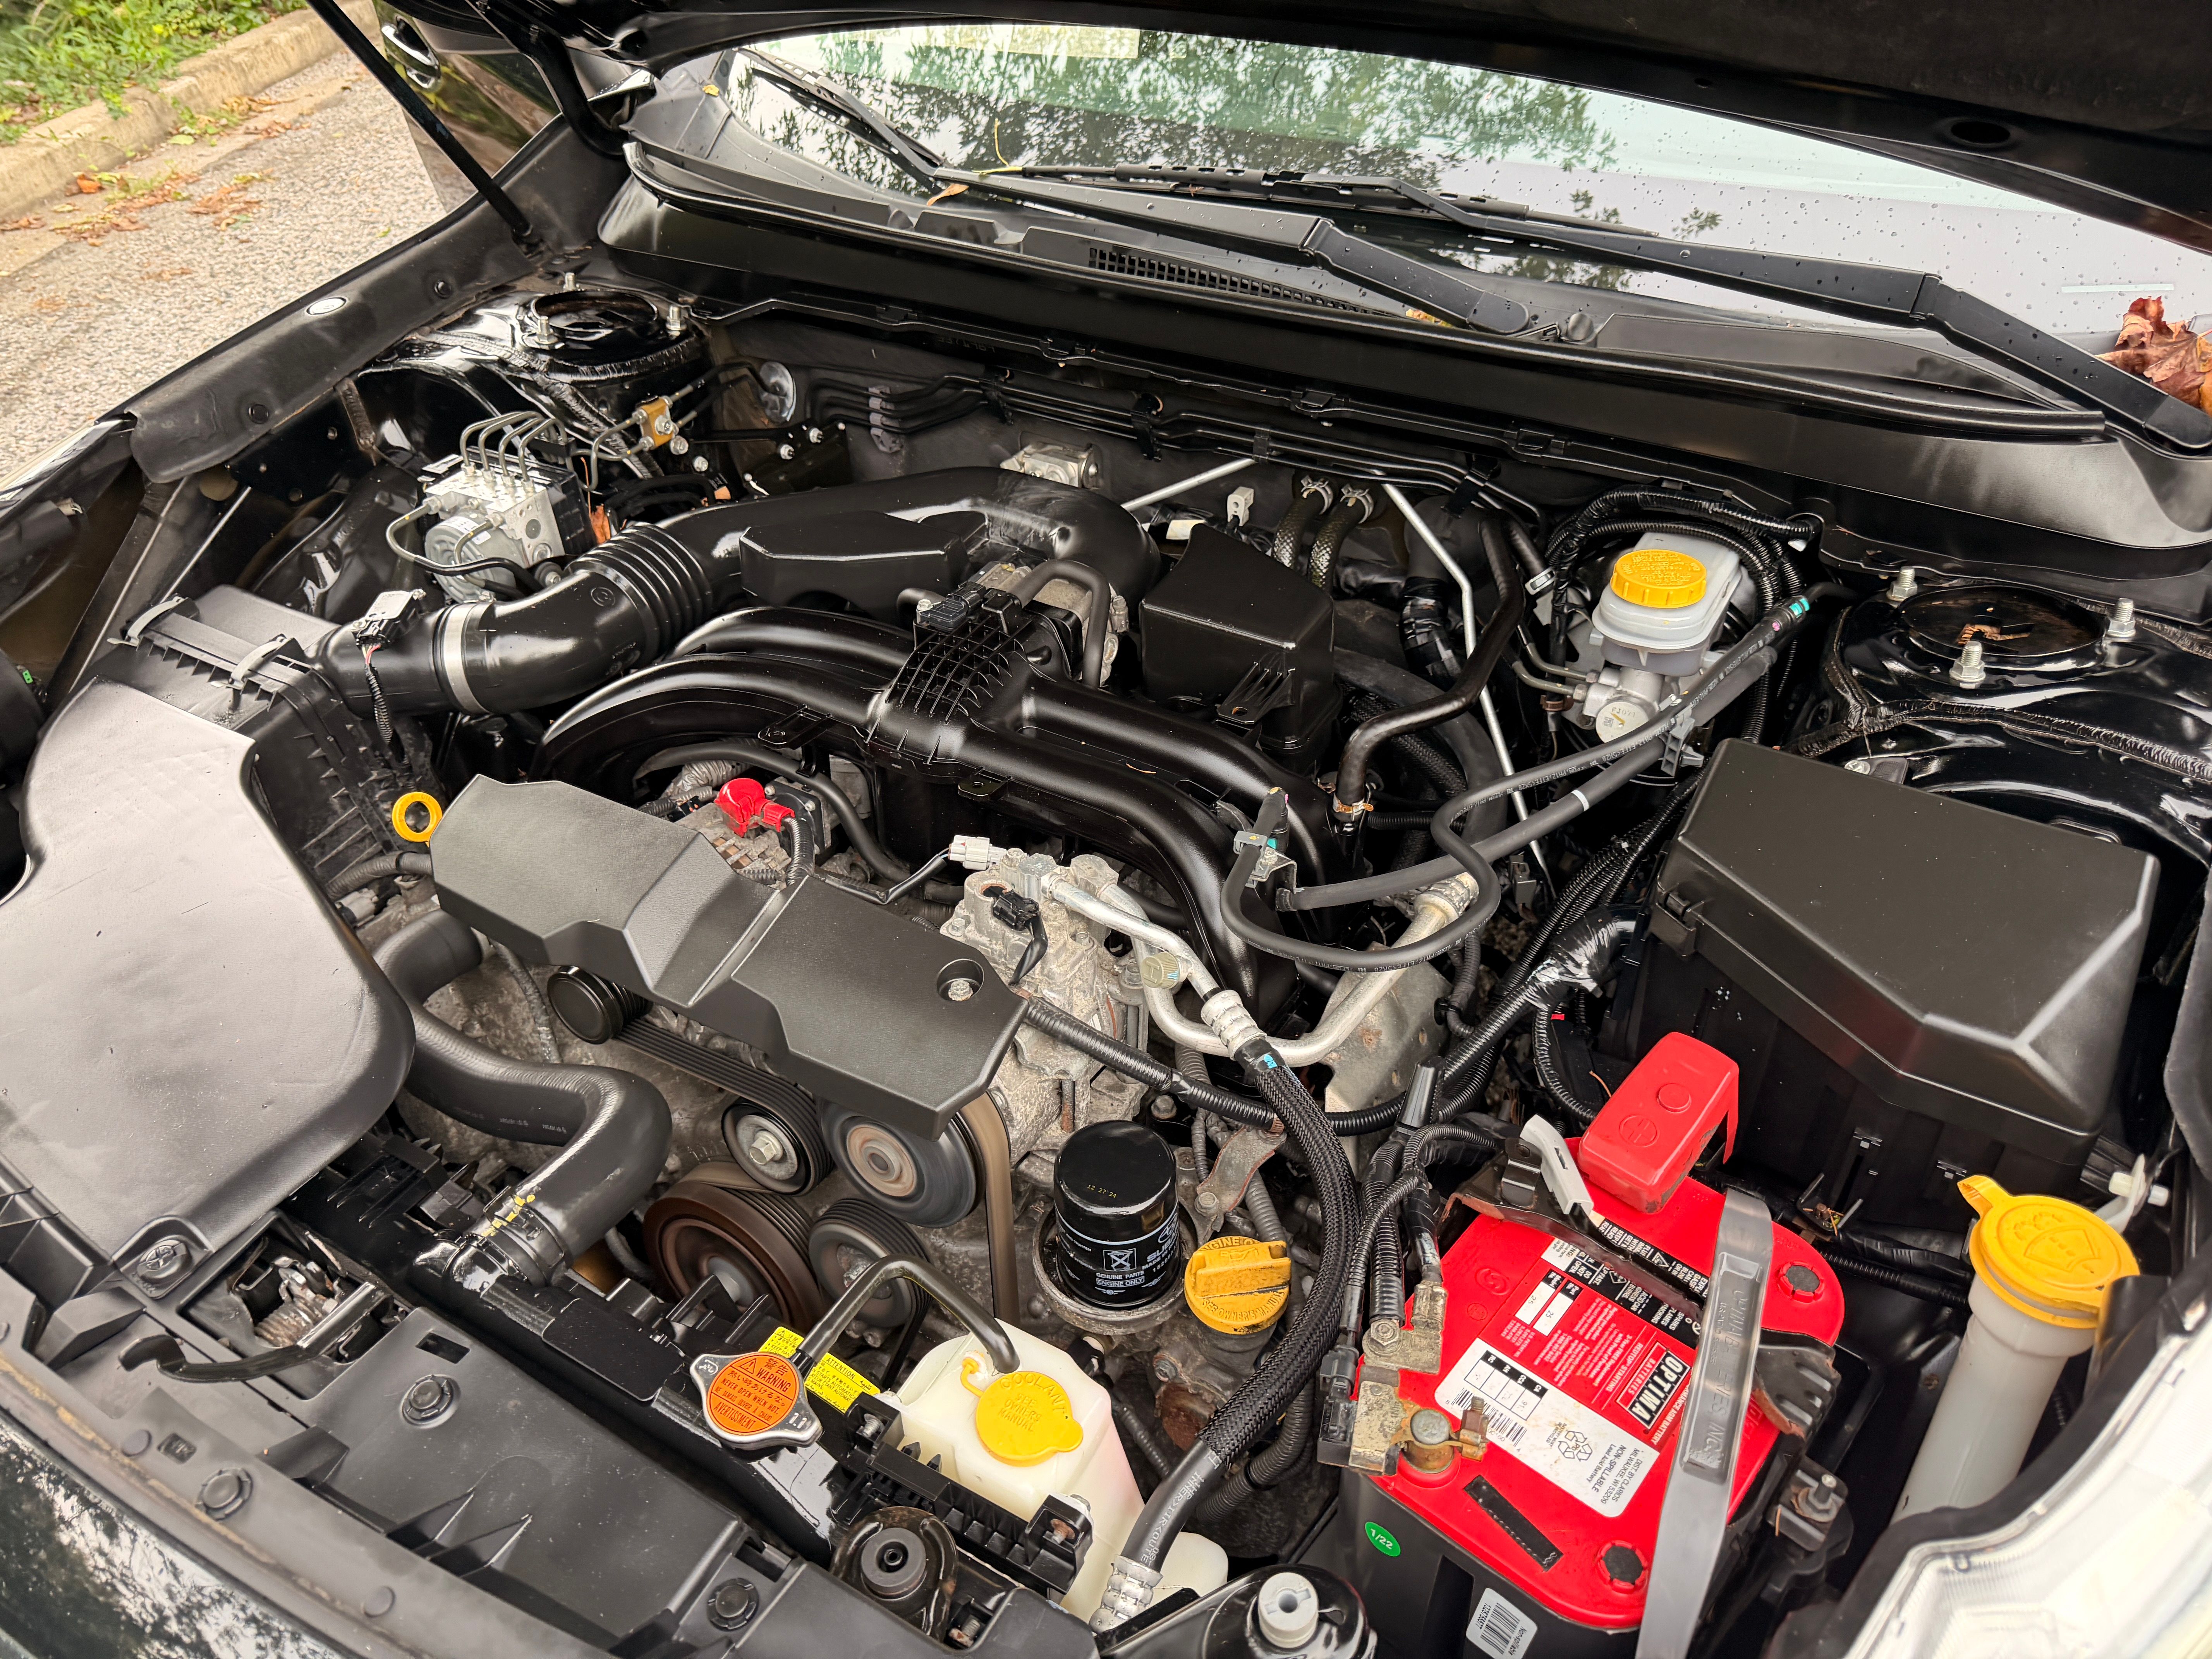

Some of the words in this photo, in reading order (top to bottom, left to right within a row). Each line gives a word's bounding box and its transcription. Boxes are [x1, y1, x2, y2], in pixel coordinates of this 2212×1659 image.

[1613, 1229, 1625, 1242] KEEP
[1623, 1234, 1633, 1245] GET
[1200, 1237, 1240, 1251] NGINE
[1142, 1258, 1161, 1270] MADE
[1568, 1259, 1582, 1275] OPEN.
[1575, 1264, 1587, 1277] NOT
[1097, 1278, 1123, 1286] ENGINE
[1125, 1277, 1144, 1286] ONLY
[1125, 1270, 1144, 1279] PARTS
[1548, 1273, 1562, 1288] Model
[1583, 1269, 1592, 1279] DO
[1592, 1271, 1606, 1286] FAST.
[1569, 1284, 1580, 1296] Part
[1635, 1290, 1649, 1304] ACID
[1202, 1298, 1218, 1313] SEE
[1256, 1291, 1285, 1317] MANUAL
[1629, 1300, 1641, 1312] CAN
[1650, 1301, 1669, 1325] SMOKING
[1660, 1307, 1677, 1327] FLAMES
[1668, 1311, 1685, 1331] SPARKS
[1487, 1354, 1496, 1364] RC
[1611, 1347, 1623, 1360] FREE
[764, 1356, 790, 1379] 警告
[825, 1357, 856, 1380] ATTENTION
[1501, 1364, 1511, 1374] AH
[755, 1367, 792, 1393] WARNING
[816, 1370, 832, 1383] STARTS
[1516, 1374, 1527, 1385] CCA
[1605, 1364, 1628, 1393] STARTING
[1627, 1357, 1657, 1395] BATTERIES
[1000, 1372, 1067, 1414] COOLANT
[1532, 1383, 1542, 1393] CA
[1630, 1355, 1685, 1421] OPTIMA
[720, 1377, 738, 1391] NEVER
[737, 1386, 752, 1399] OPEN
[752, 1395, 768, 1408] WHEN
[767, 1403, 781, 1415] HOT.
[1016, 1393, 1037, 1408] SEE
[713, 1400, 756, 1431] AVERTISSMENT
[788, 1411, 808, 1431] 1.1
[998, 1408, 1037, 1432] MANUAL
[1664, 1408, 1677, 1422] AGM
[1649, 1419, 1670, 1446] BATTERY
[1570, 1442, 1581, 1453] Pb
[1604, 1443, 1616, 1456] Lead
[1598, 1454, 1609, 1467] Acid
[1615, 1447, 1640, 1480] MILWAUKEE,
[1630, 1458, 1643, 1472] DIST.
[1586, 1464, 1602, 1484] Battery
[1591, 1444, 1627, 1493] NON-SPILLABLE
[1625, 1470, 1635, 1480] BY
[1611, 1478, 1620, 1488] WI
[1611, 1478, 1630, 1502] CLARIOS
[1599, 1485, 1615, 1505] 53209
[1370, 1528, 1394, 1550] 1/22
